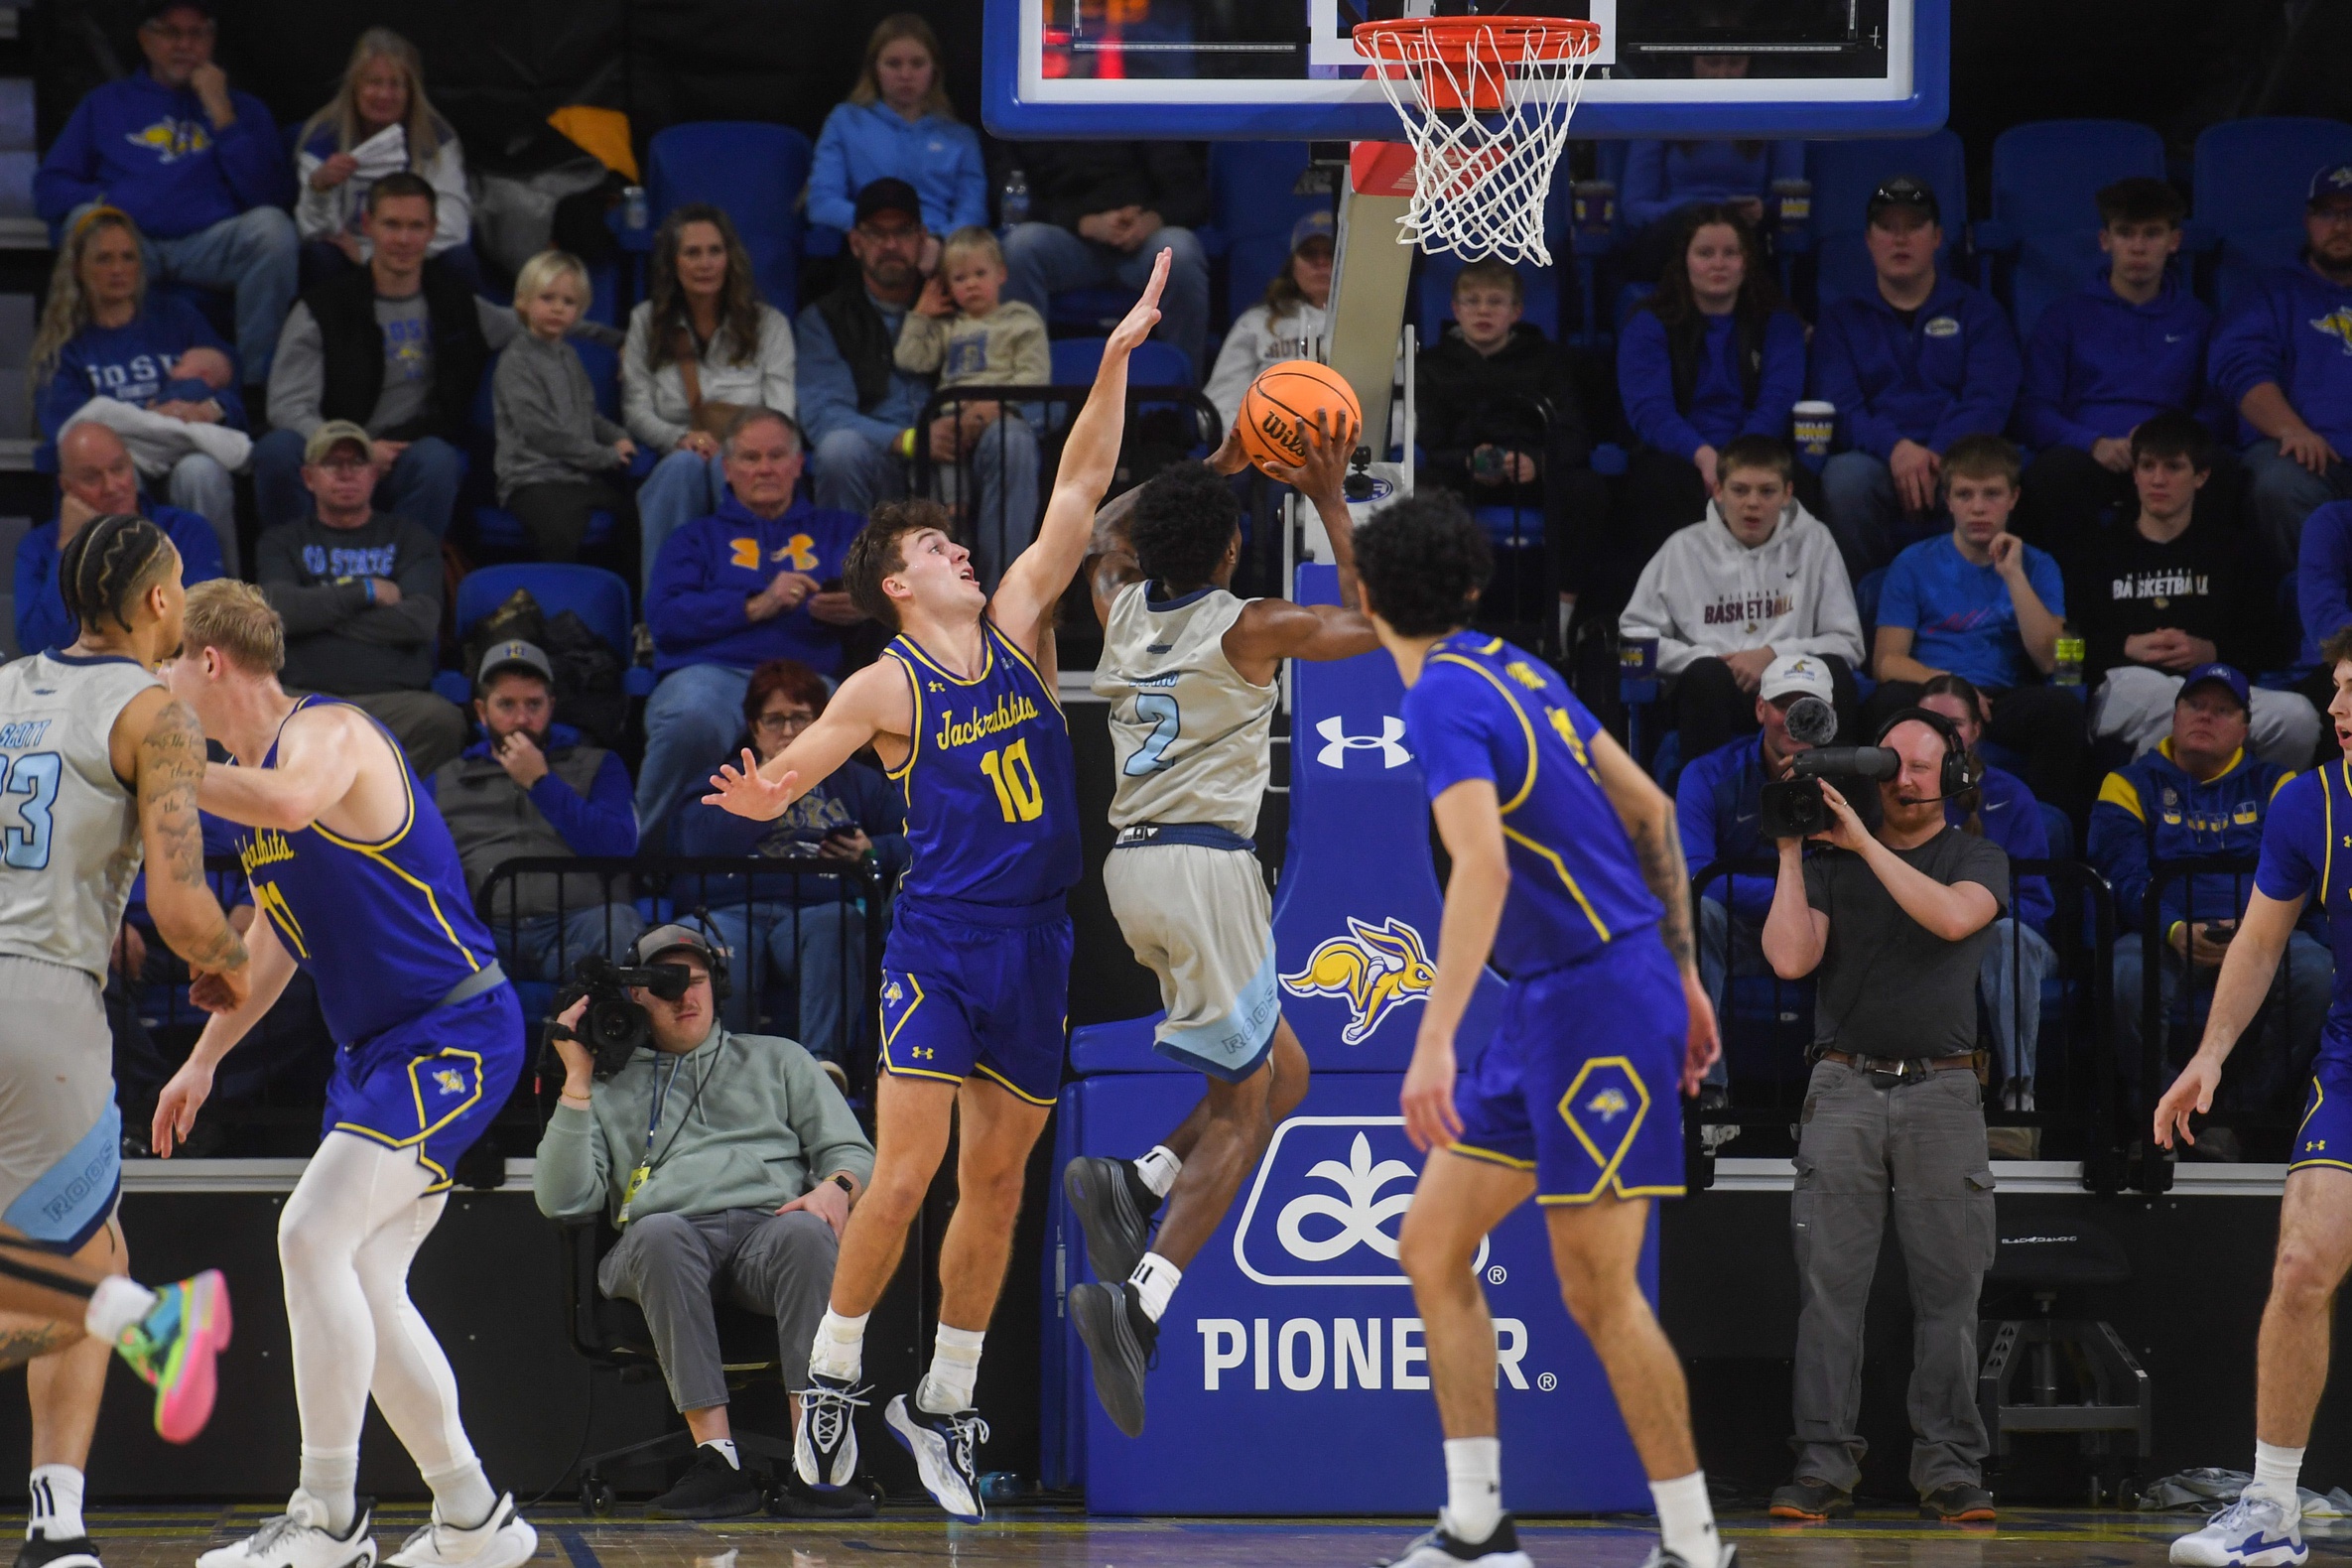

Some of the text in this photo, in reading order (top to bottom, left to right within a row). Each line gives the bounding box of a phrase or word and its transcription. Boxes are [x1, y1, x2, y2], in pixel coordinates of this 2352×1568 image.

[1262, 410, 1307, 457] Wils
[330, 544, 396, 577] STATE
[2113, 576, 2208, 599] BASKETBALL
[1704, 595, 1794, 624] BASKETBALL
[0, 719, 52, 748] SCOTT
[1122, 692, 1181, 777] 2
[980, 737, 1043, 823] 10
[0, 751, 62, 870] 3
[43, 1138, 114, 1224] ROOS
[1197, 1317, 1529, 1390] PIONER
